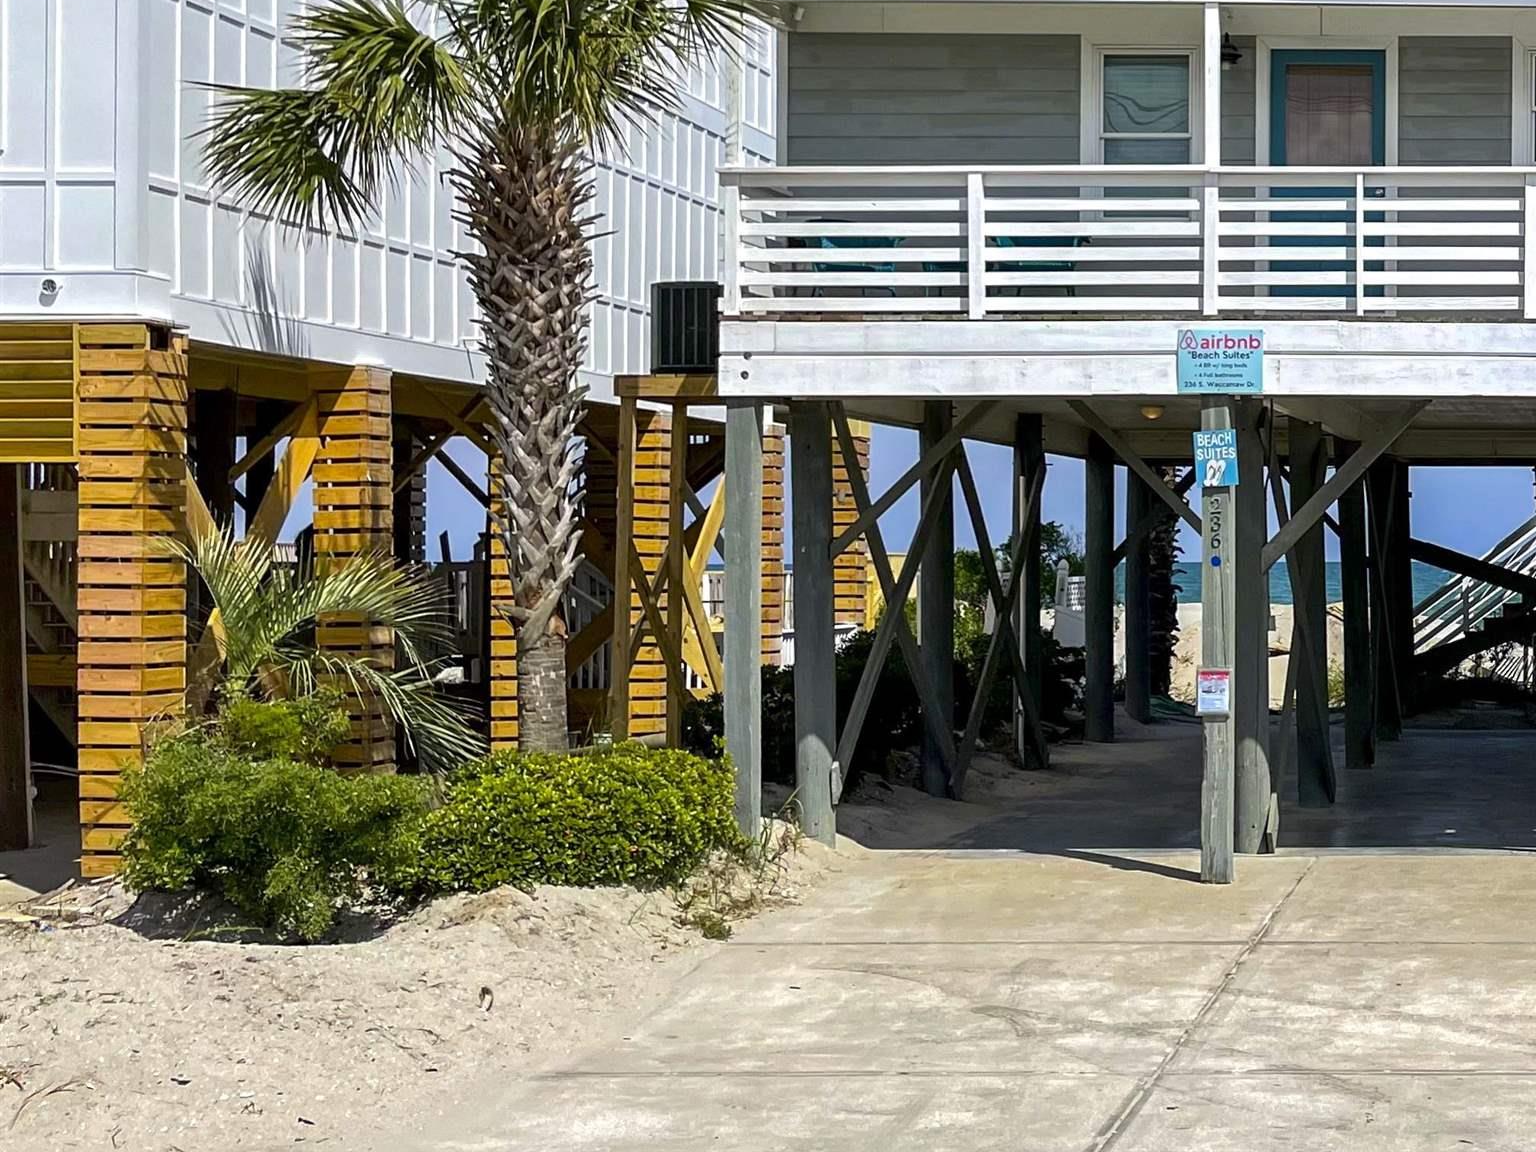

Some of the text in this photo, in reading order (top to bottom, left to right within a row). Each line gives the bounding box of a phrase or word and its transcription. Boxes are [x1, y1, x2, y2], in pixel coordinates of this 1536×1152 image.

[1201, 334, 1261, 349] airbnb
[1188, 351, 1254, 359] "Beach Suites"
[1197, 432, 1232, 447] BEACH
[1196, 447, 1236, 460] SUITES
